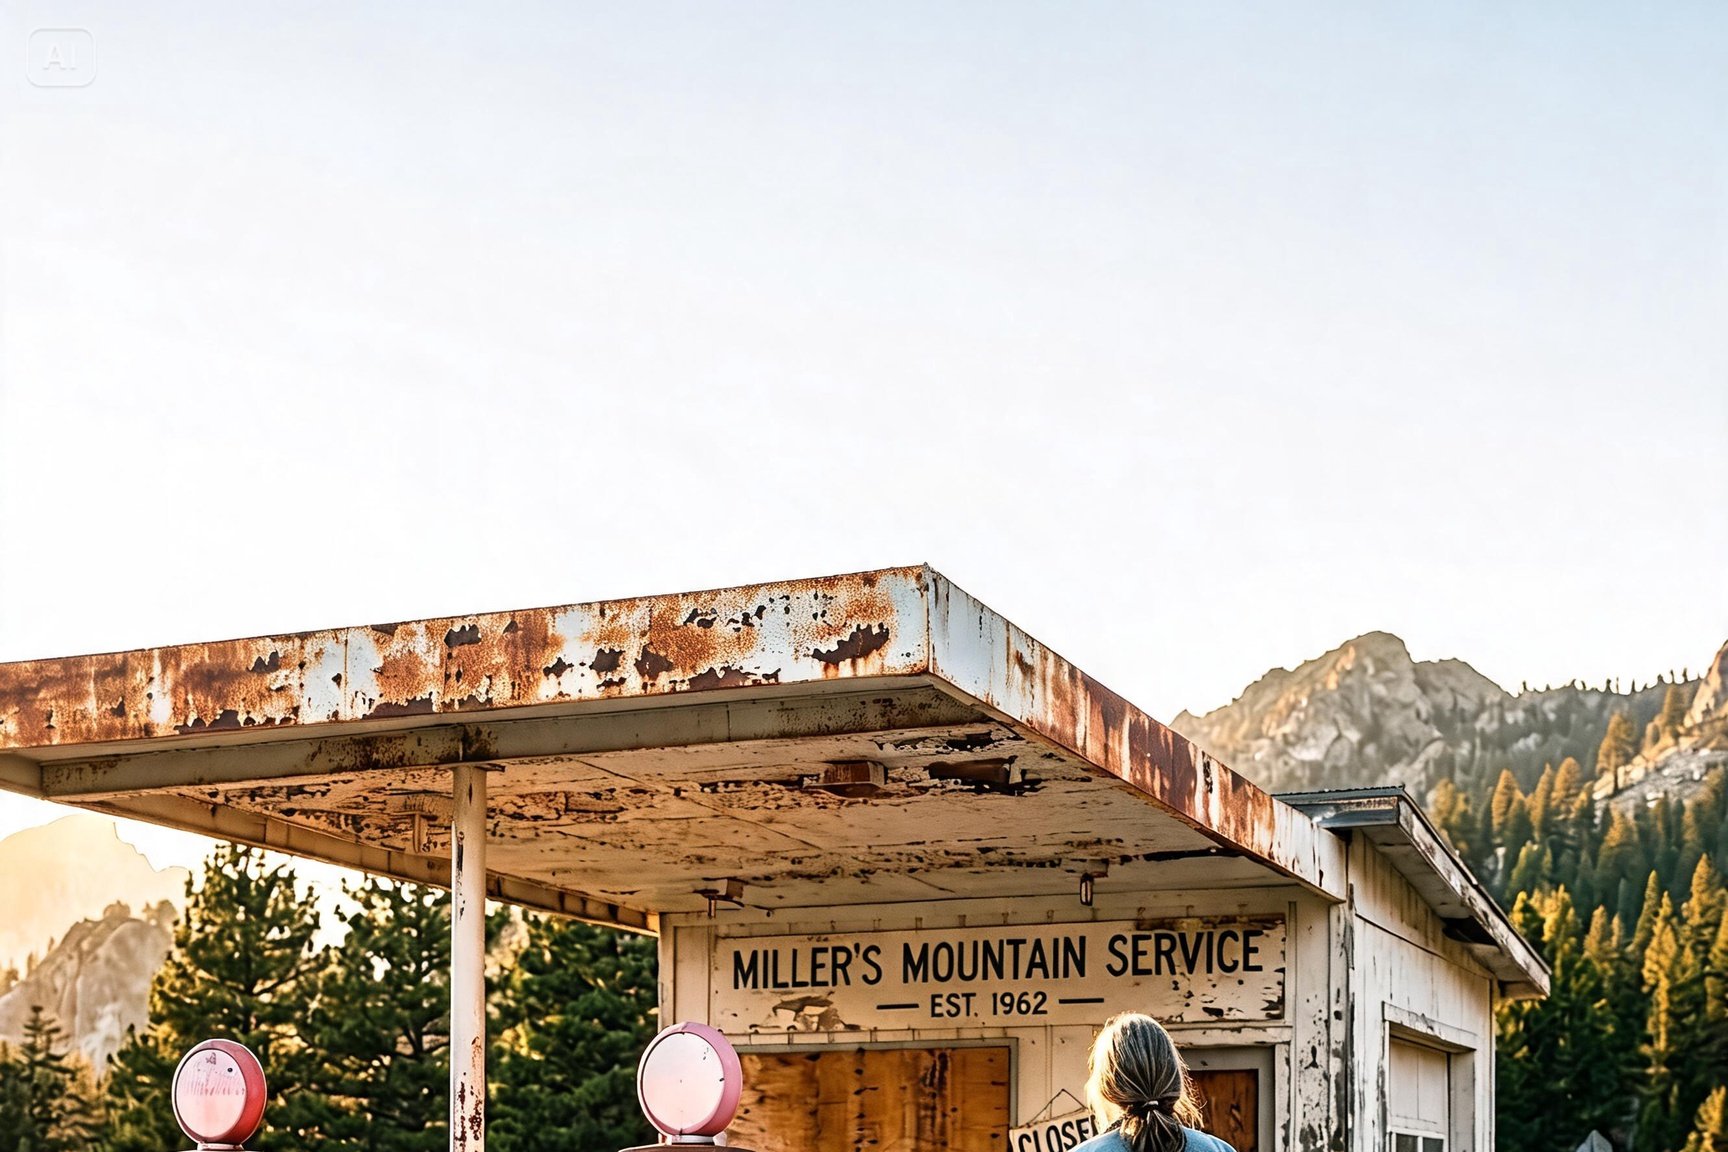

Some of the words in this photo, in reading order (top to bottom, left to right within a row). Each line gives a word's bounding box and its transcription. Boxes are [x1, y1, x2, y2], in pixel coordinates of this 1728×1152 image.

[733, 943, 882, 989] MILLER'S
[902, 935, 1087, 983] MOUNTAIN
[1106, 929, 1264, 977] SERVICE
[930, 992, 978, 1018] EST.
[992, 990, 1048, 1015] 1962
